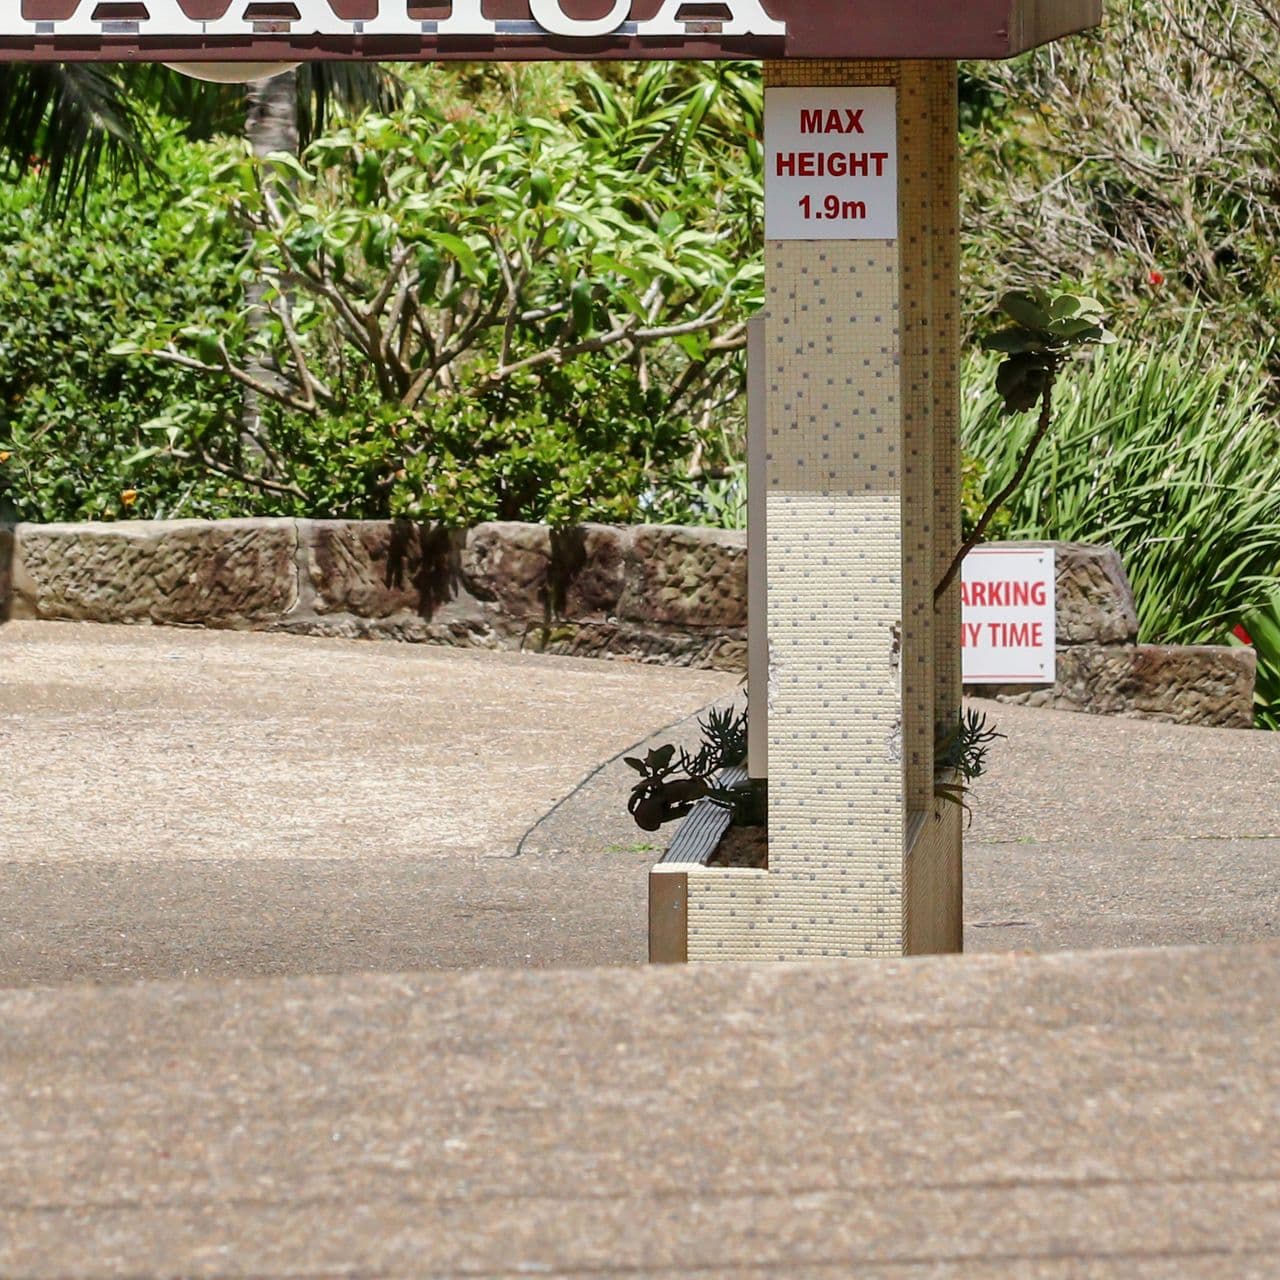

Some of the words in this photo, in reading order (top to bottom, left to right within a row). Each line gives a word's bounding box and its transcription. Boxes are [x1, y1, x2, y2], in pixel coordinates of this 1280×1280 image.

[799, 108, 865, 134] MAX
[775, 151, 889, 177] HEIGHT
[798, 194, 867, 220] 1.9m
[961, 581, 1047, 607] ARKING
[987, 622, 1043, 648] TIME
